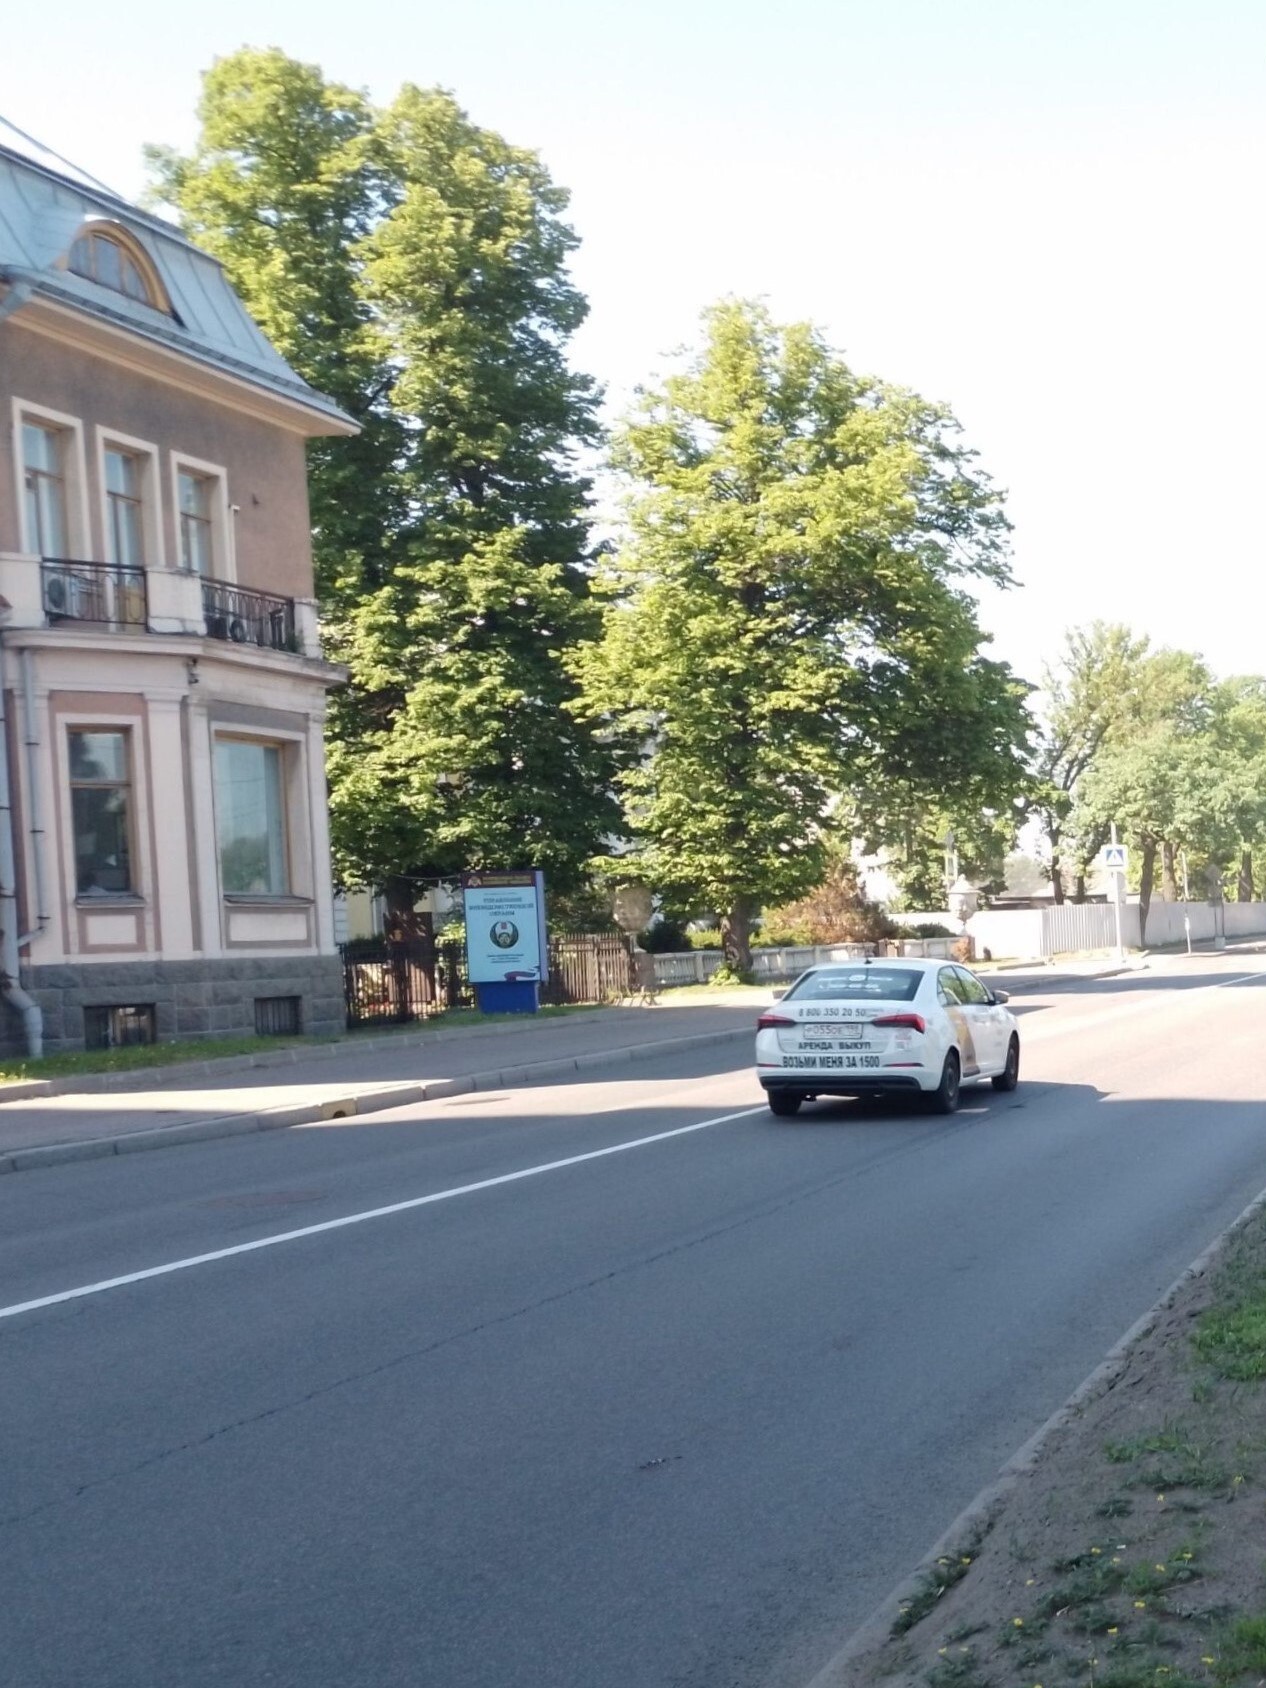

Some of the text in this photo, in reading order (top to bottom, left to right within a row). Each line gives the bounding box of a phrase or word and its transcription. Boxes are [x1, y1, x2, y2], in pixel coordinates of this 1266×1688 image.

[806, 1008, 821, 1016] 800
[823, 1008, 839, 1016] 350
[842, 1008, 853, 1016] 20
[855, 1008, 866, 1016] 50
[798, 1042, 871, 1050] АРЕНДА ВЫКУП
[782, 1056, 880, 1068] ВОЗЬМИ МЕНЯ ЗА 1500
